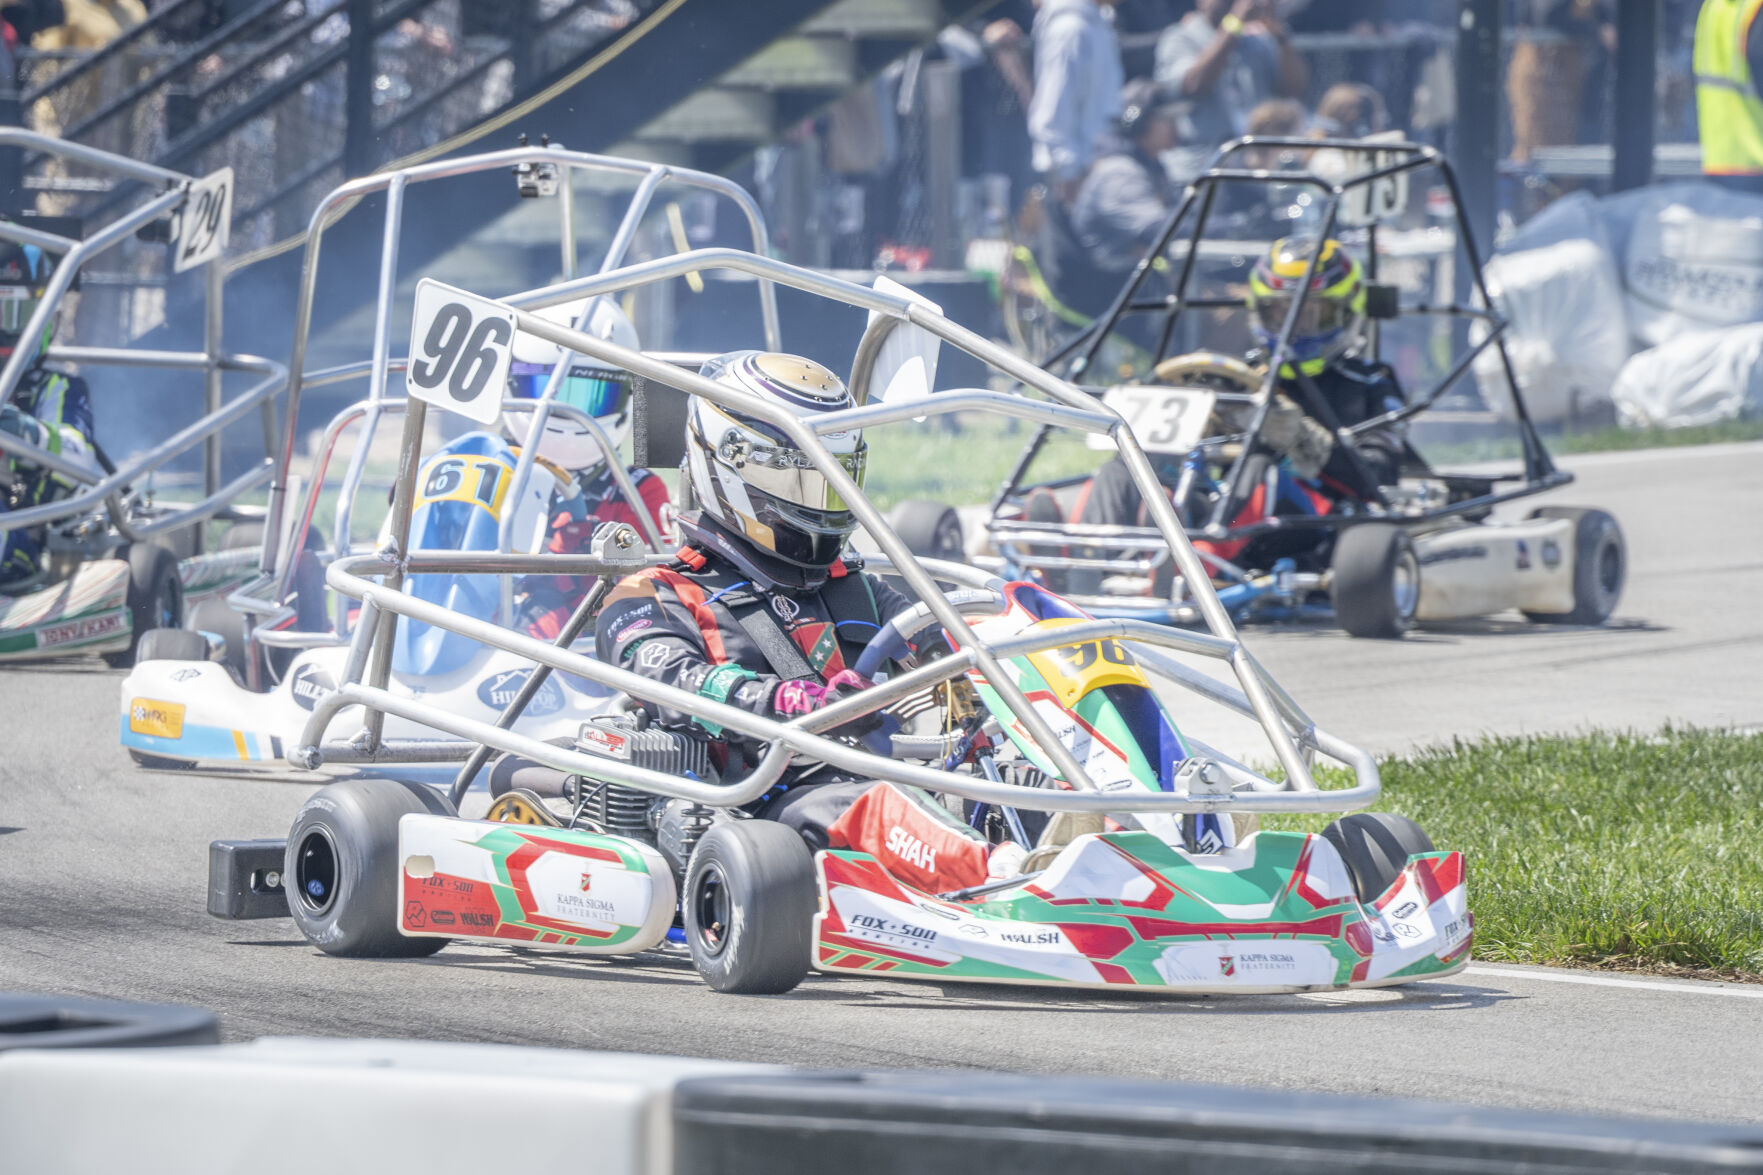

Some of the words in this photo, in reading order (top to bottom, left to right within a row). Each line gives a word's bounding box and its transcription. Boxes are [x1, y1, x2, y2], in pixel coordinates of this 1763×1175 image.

[183, 184, 226, 260] 29
[412, 303, 512, 402] 96
[1124, 396, 1189, 444] 73
[424, 459, 503, 508] 61
[885, 825, 937, 873] SHAH
[556, 893, 584, 908] KAPPA
[585, 898, 615, 912] SIGMA
[556, 904, 616, 921] FRATERNITY
[851, 914, 888, 930] FOX
[899, 924, 937, 940] SON
[1001, 932, 1059, 944] WALSH
[1239, 953, 1268, 962] KAPPA
[1270, 953, 1295, 963] SIGMA
